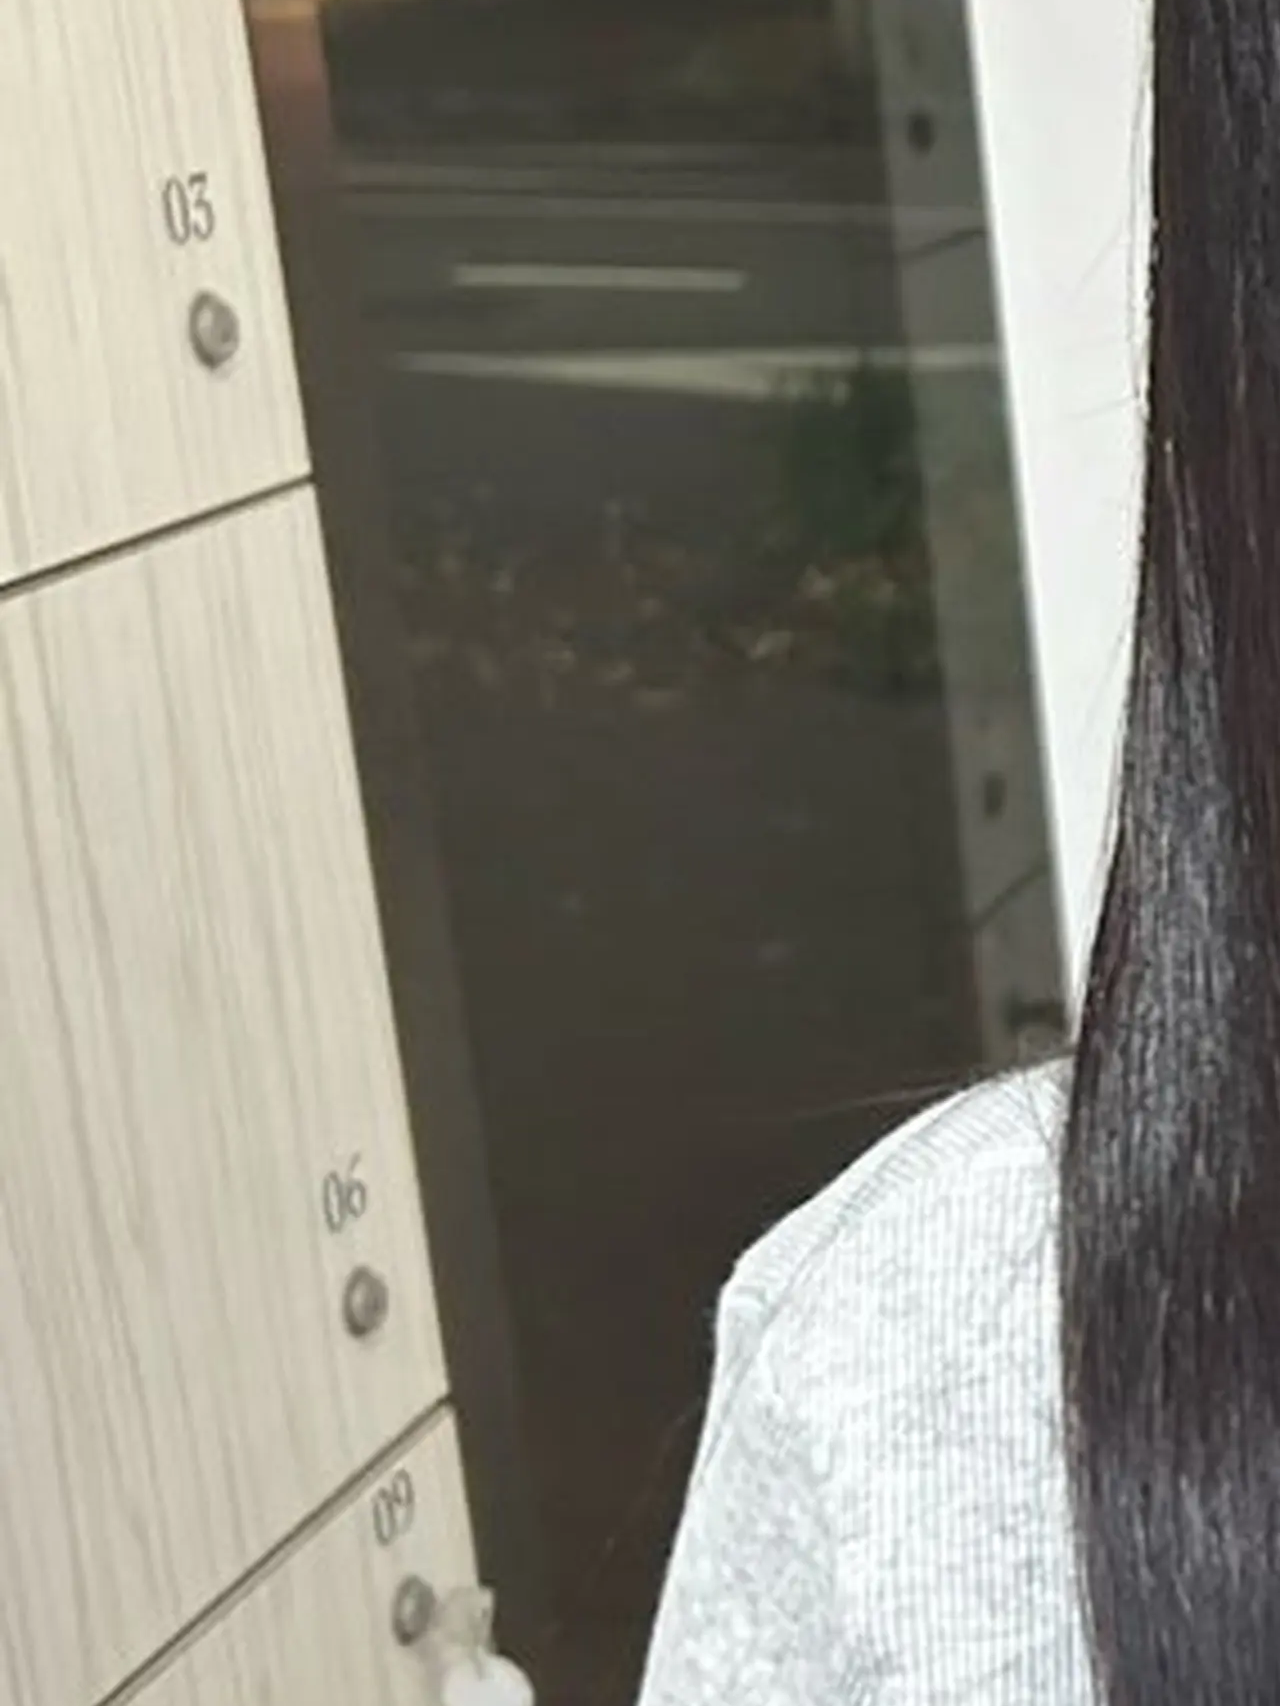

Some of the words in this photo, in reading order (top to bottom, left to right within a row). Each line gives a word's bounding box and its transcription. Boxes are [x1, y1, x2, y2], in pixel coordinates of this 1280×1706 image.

[162, 170, 215, 246] 03
[323, 1151, 366, 1234] 06
[372, 1466, 415, 1547] 09
